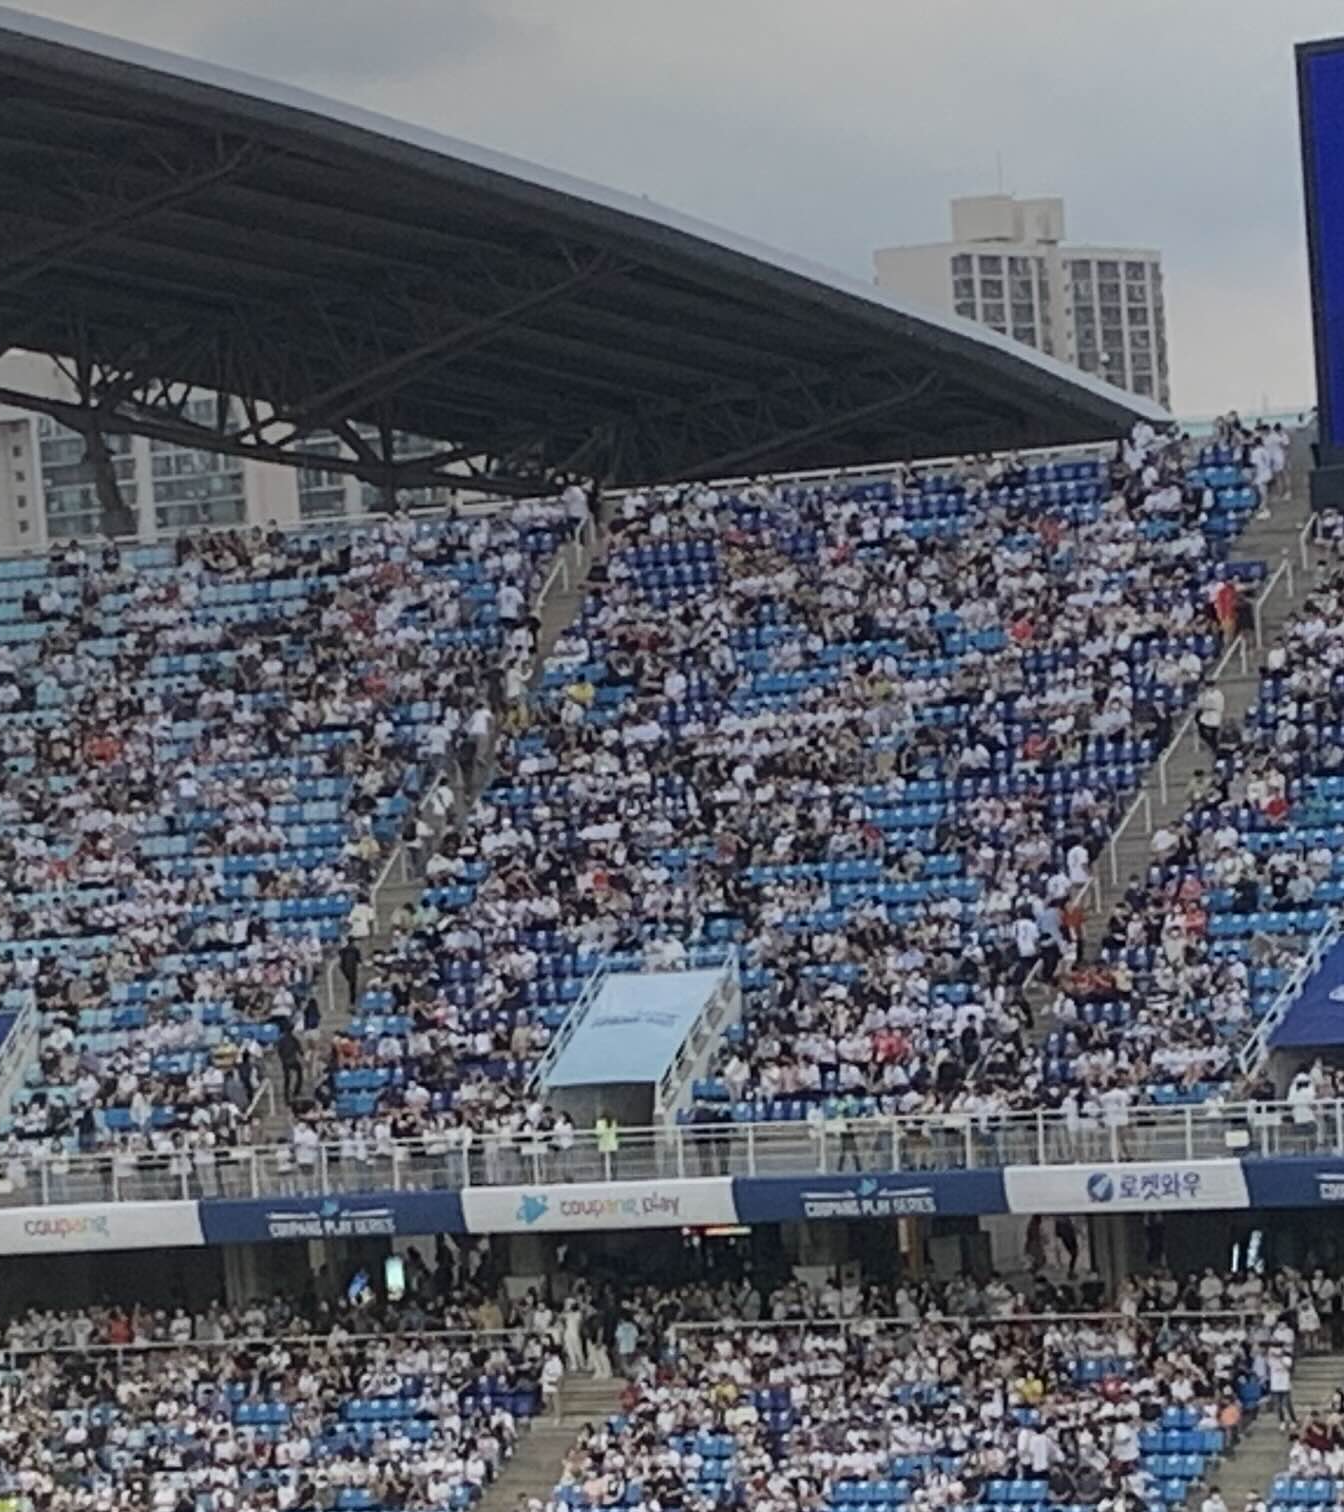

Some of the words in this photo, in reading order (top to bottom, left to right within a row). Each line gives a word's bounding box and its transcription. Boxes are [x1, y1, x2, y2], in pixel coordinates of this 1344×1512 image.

[1117, 1170, 1202, 1199] 로켓와우
[560, 1197, 640, 1219] coupang
[641, 1191, 680, 1217] play
[24, 1216, 111, 1238] coupang
